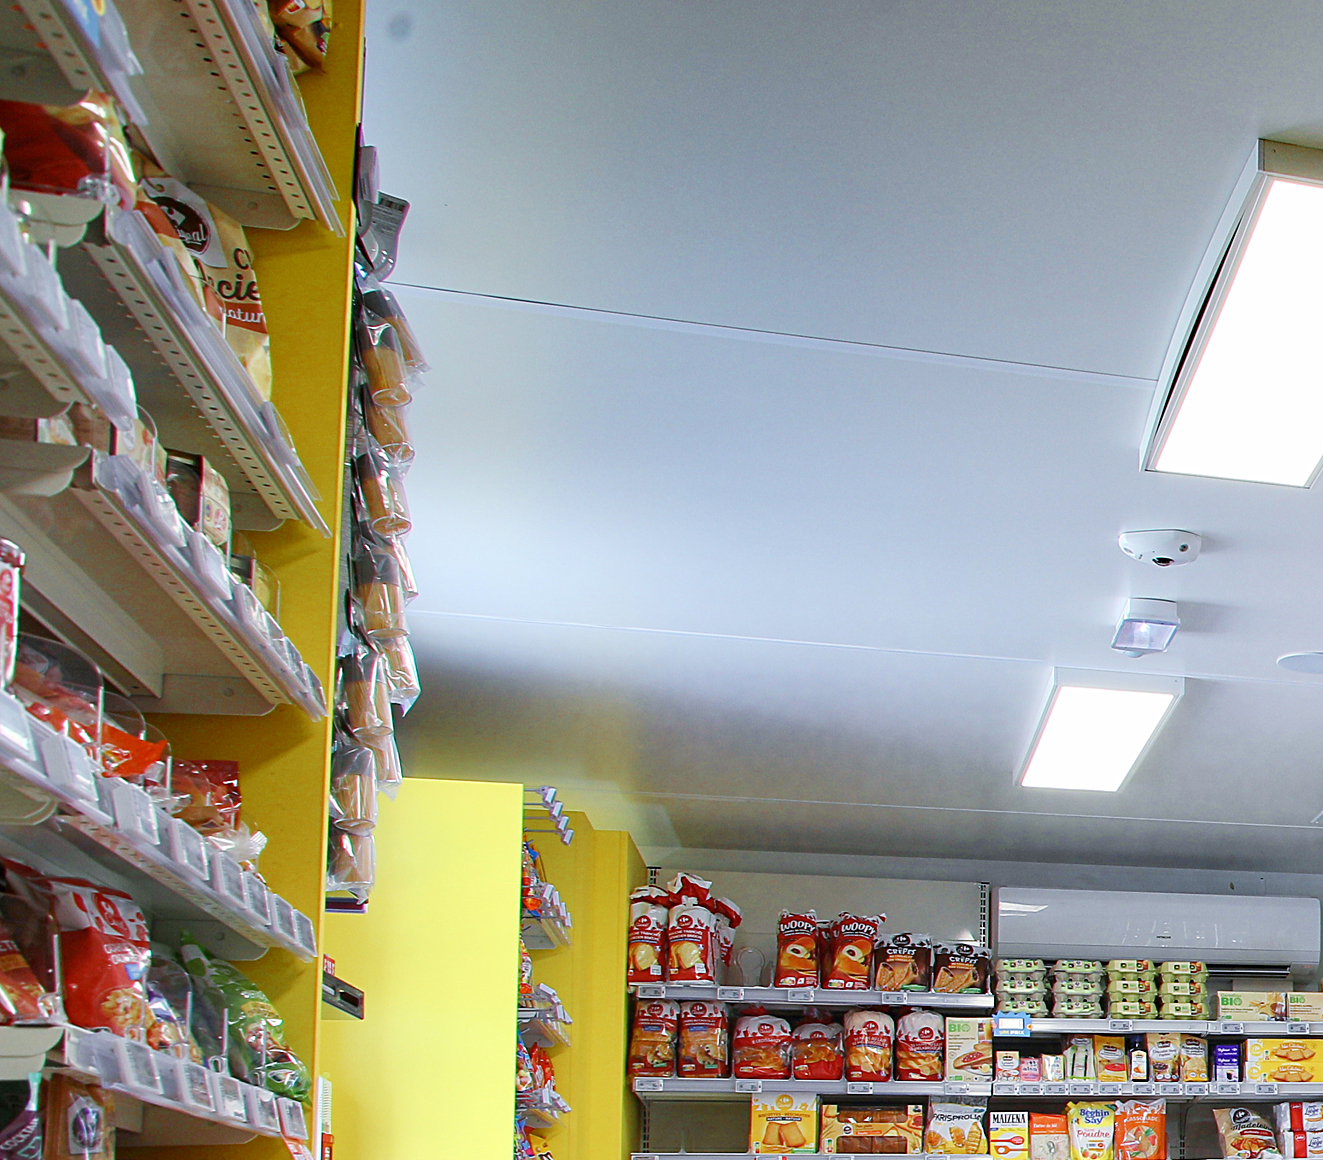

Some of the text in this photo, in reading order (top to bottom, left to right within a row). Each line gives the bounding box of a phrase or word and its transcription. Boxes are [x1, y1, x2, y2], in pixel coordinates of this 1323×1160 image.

[780, 920, 816, 934] WOOPY
[841, 922, 875, 936] WOOPY
[1220, 996, 1243, 1007] BIO
[1289, 994, 1306, 1005] BIO
[948, 1023, 970, 1033] BIO
[992, 1113, 1026, 1124] MAIZENA
[1084, 1114, 1103, 1125] Say
[1077, 1129, 1110, 1138] Poudre
